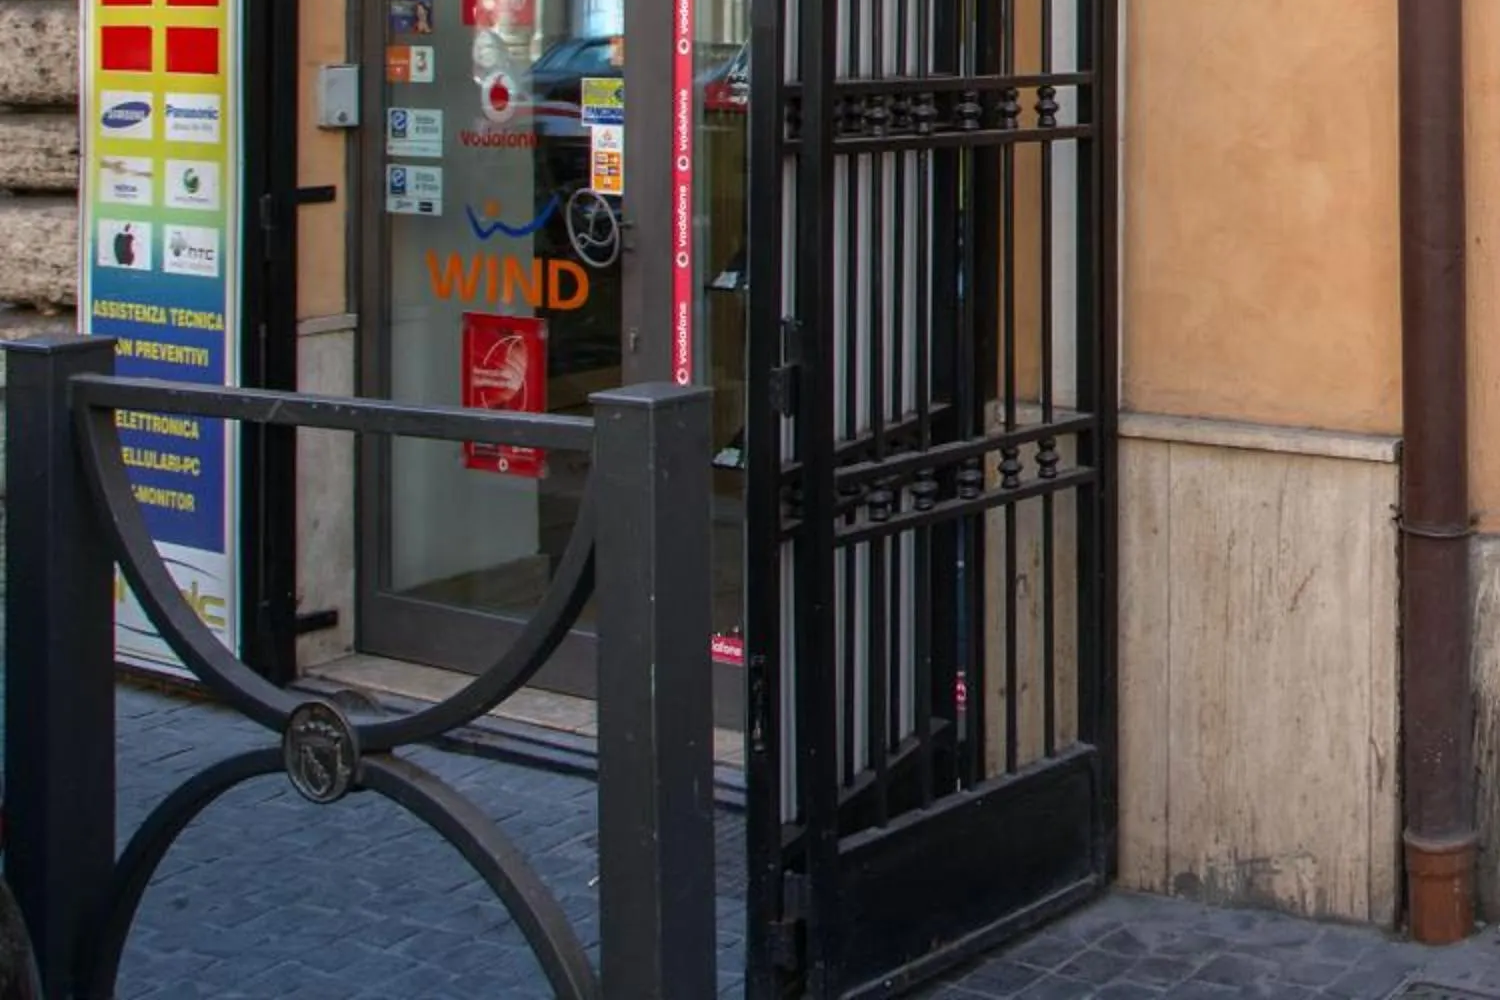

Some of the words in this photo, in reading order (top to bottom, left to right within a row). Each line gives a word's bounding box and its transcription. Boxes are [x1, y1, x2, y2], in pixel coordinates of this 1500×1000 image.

[678, 88, 688, 152] vodafone
[458, 127, 540, 148] vodafone
[678, 185, 687, 247] vodafone
[425, 247, 589, 310] WIND
[93, 299, 167, 325] ASSISTENZA
[169, 308, 225, 331] TECNICA
[677, 302, 687, 365] vodafone
[135, 340, 209, 367] PREVENTIVI
[115, 408, 199, 440] ELETTRONICA
[122, 446, 201, 477] ELLULARI-PC
[131, 483, 195, 512] -MONITOR
